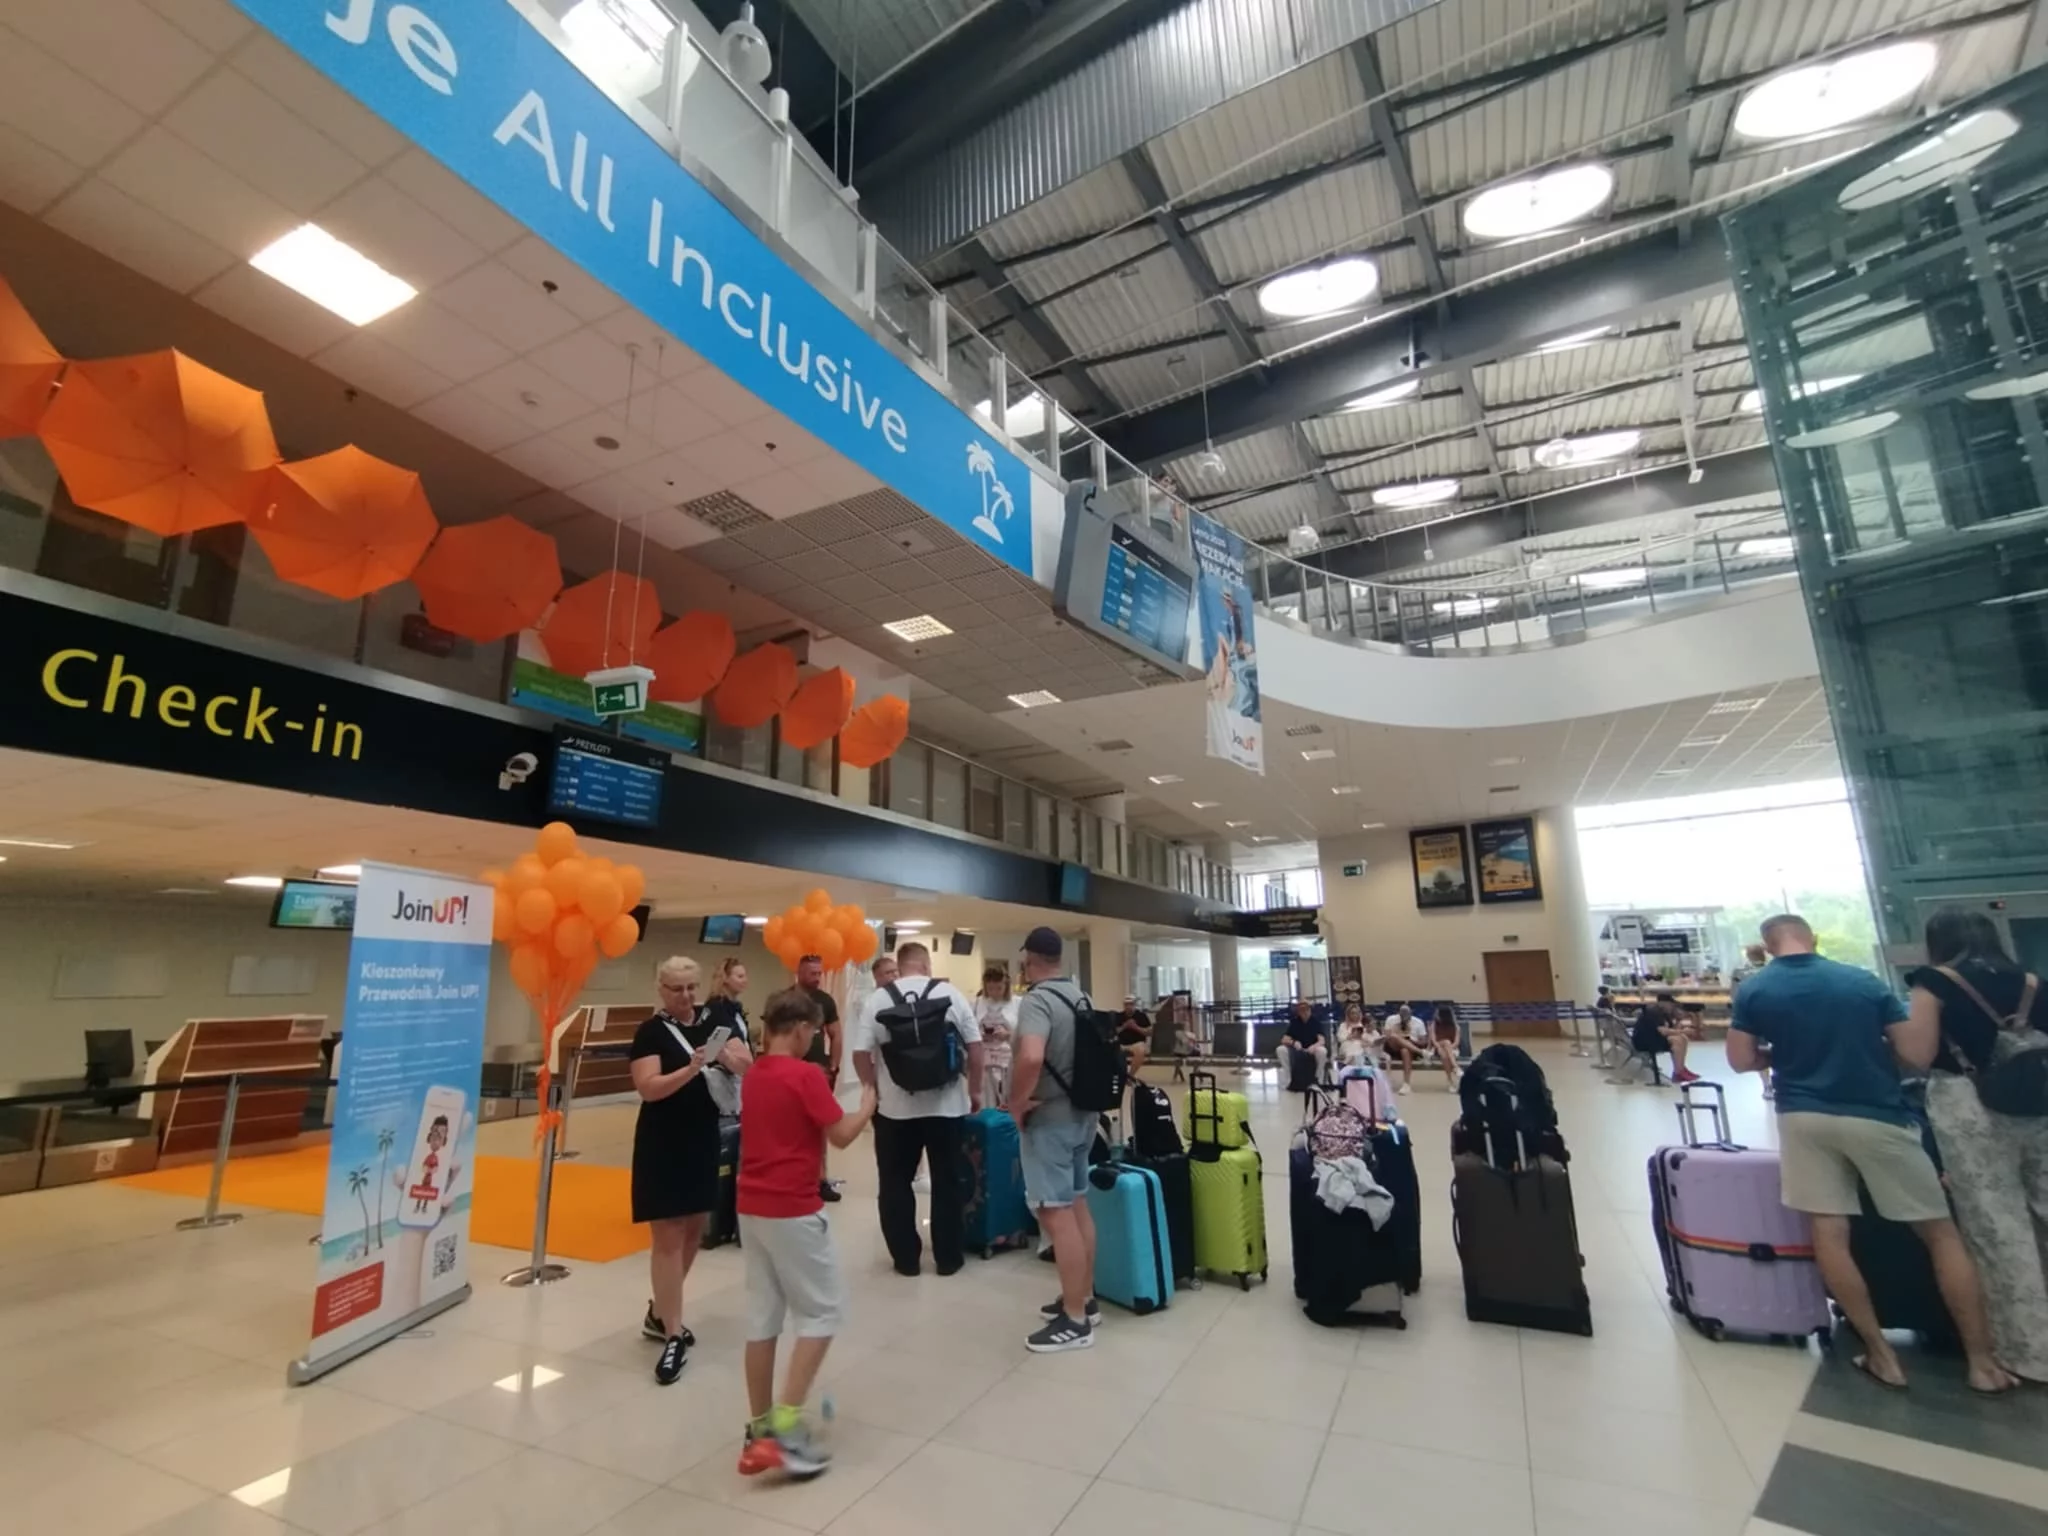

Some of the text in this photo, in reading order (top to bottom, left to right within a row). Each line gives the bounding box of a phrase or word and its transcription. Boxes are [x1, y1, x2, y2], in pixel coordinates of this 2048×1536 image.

[493, 91, 615, 231] All
[648, 199, 909, 454] Inclusive
[42, 649, 364, 761] Check-in
[359, 983, 480, 1001] Przewodnik Join UP!
[360, 961, 445, 982] Kieszonkowy
